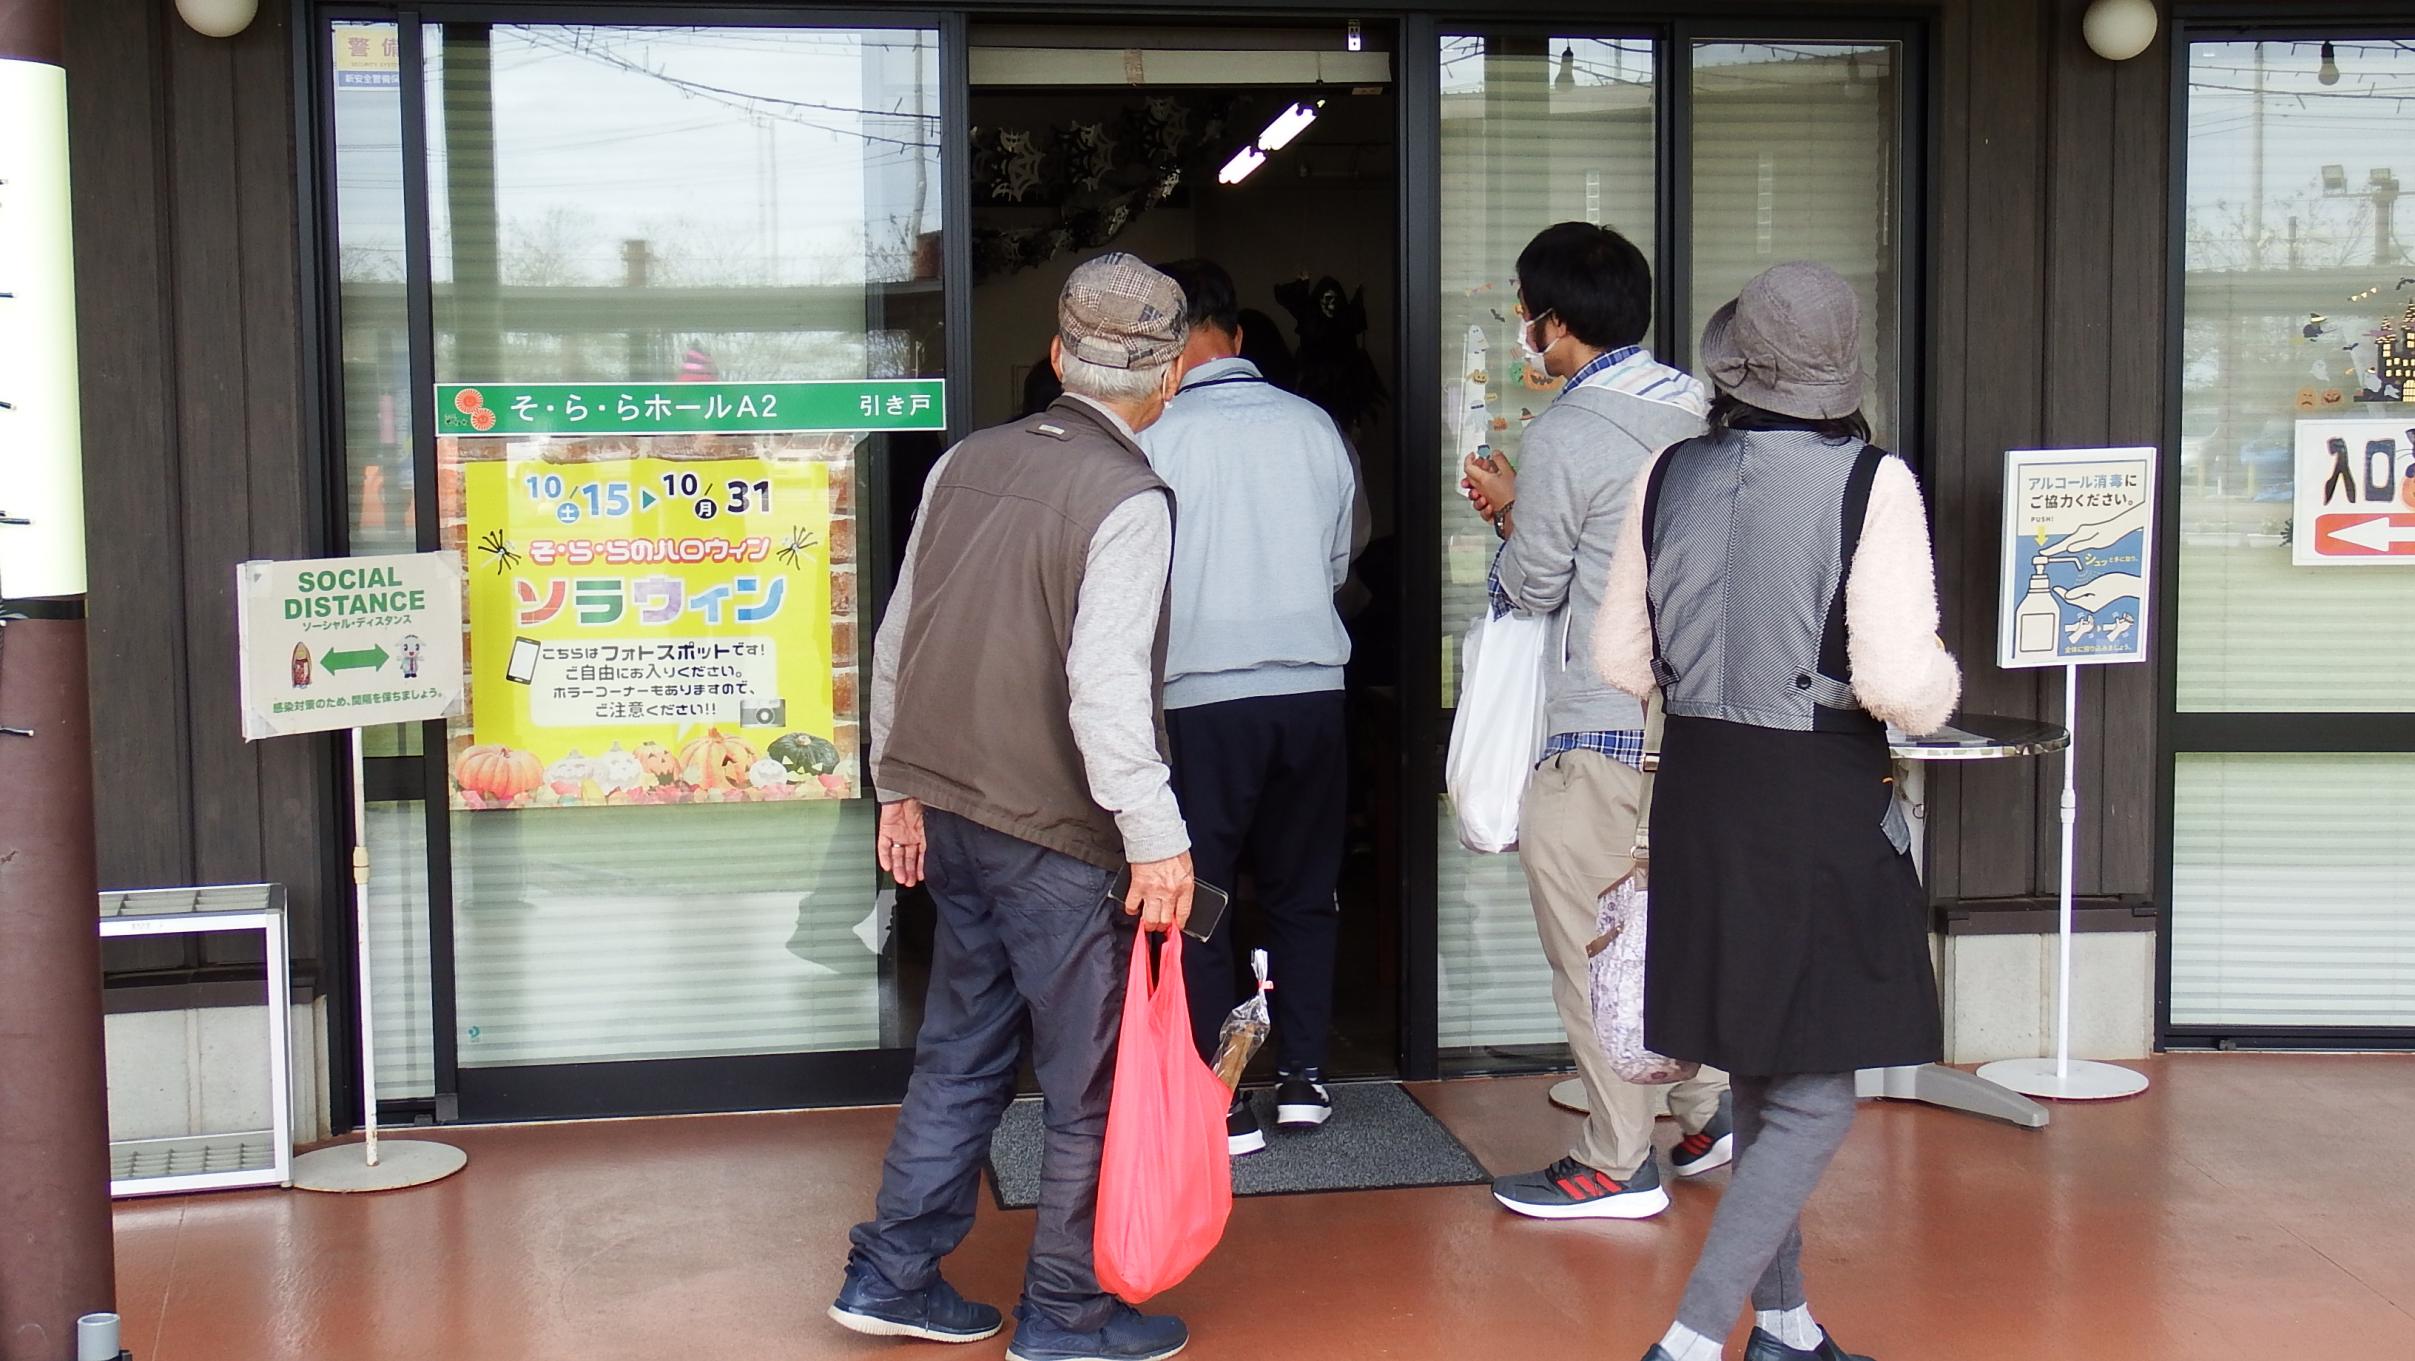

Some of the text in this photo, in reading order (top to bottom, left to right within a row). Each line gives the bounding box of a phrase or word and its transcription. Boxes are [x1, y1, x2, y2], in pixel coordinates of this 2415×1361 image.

[859, 393, 931, 417] 引き戸
[2323, 436, 2396, 506] 入口
[2028, 474, 2137, 491] アルコール消毒に
[2030, 494, 2134, 509] ご協力ください。
[298, 566, 402, 593] SOCIAL
[284, 590, 426, 620] DISTANCE
[517, 577, 785, 625] ソラウィン
[302, 614, 412, 632] ソーシャル・ディスタンス
[565, 664, 744, 682] ご自由にお入りください。
[553, 680, 757, 699] ホラーコーナーもありますので、
